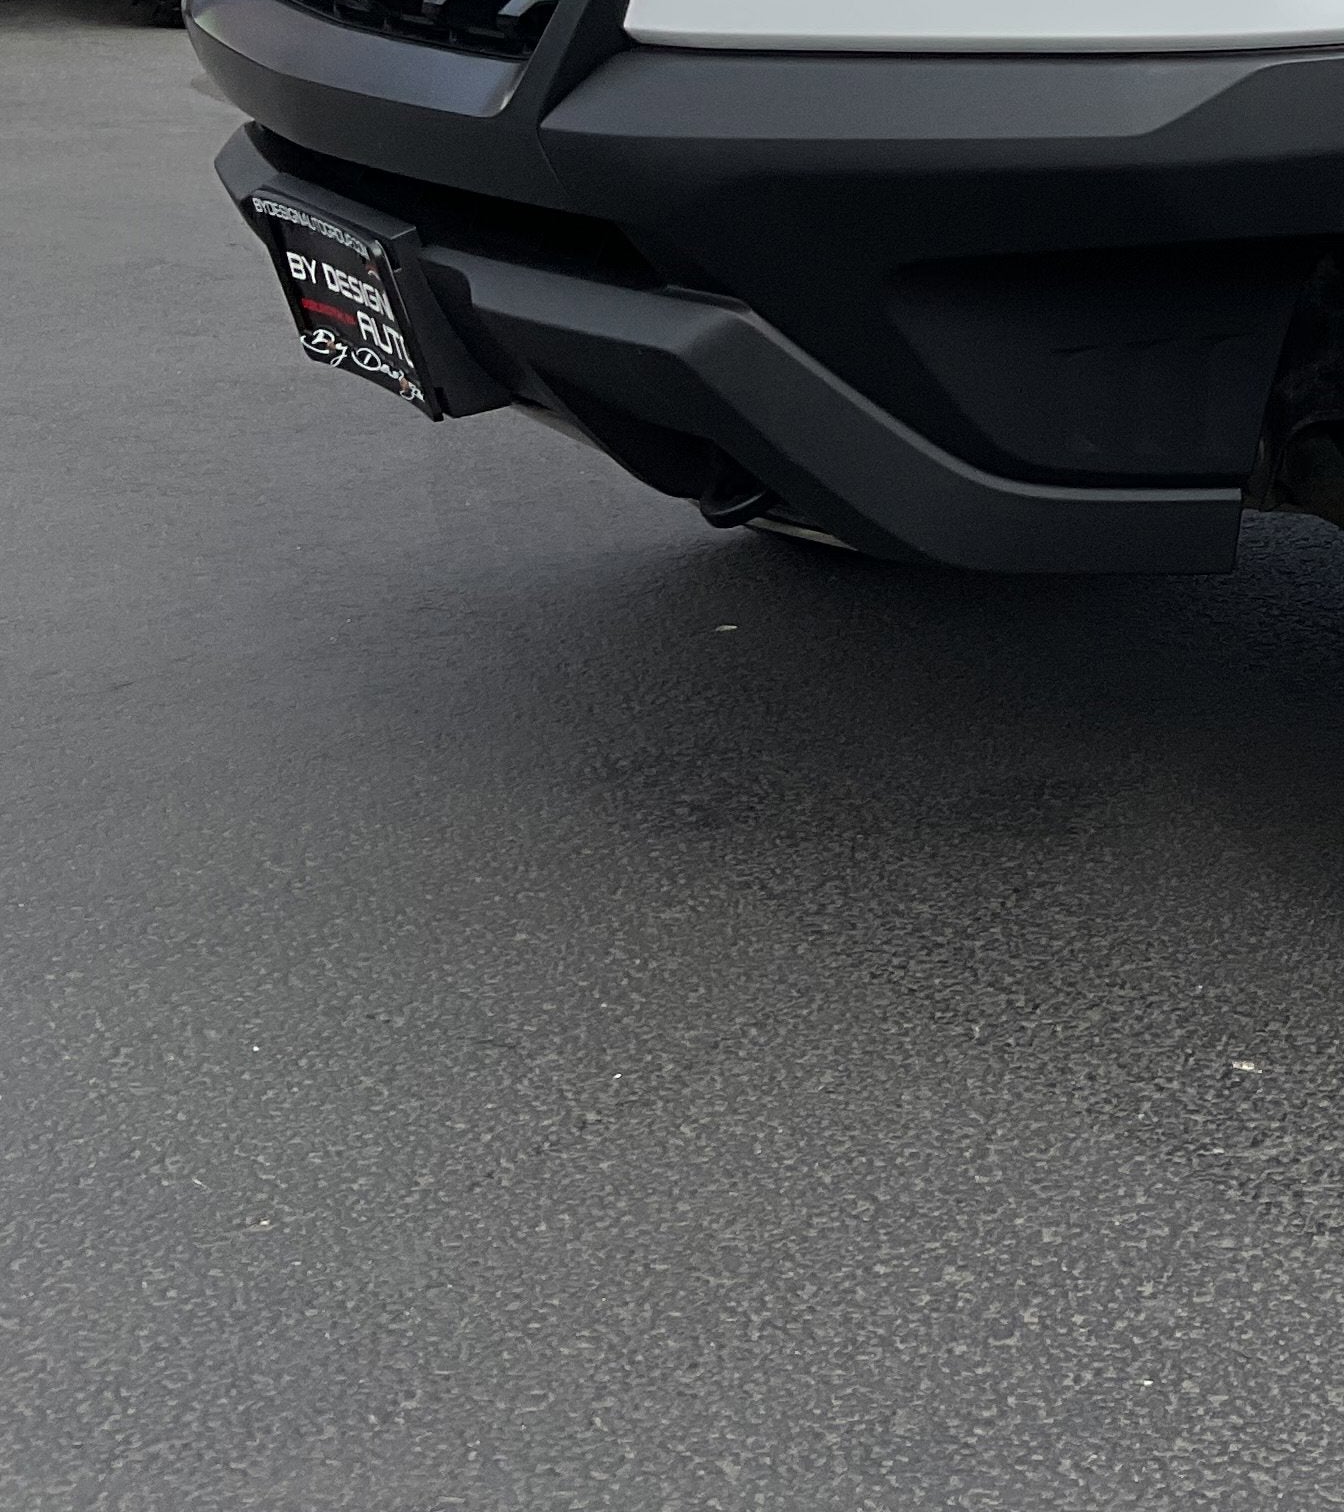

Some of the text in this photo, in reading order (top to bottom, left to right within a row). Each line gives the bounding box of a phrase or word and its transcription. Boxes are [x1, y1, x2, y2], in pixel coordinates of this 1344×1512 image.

[286, 251, 395, 322] BY DESIGN
[300, 329, 348, 368] By
